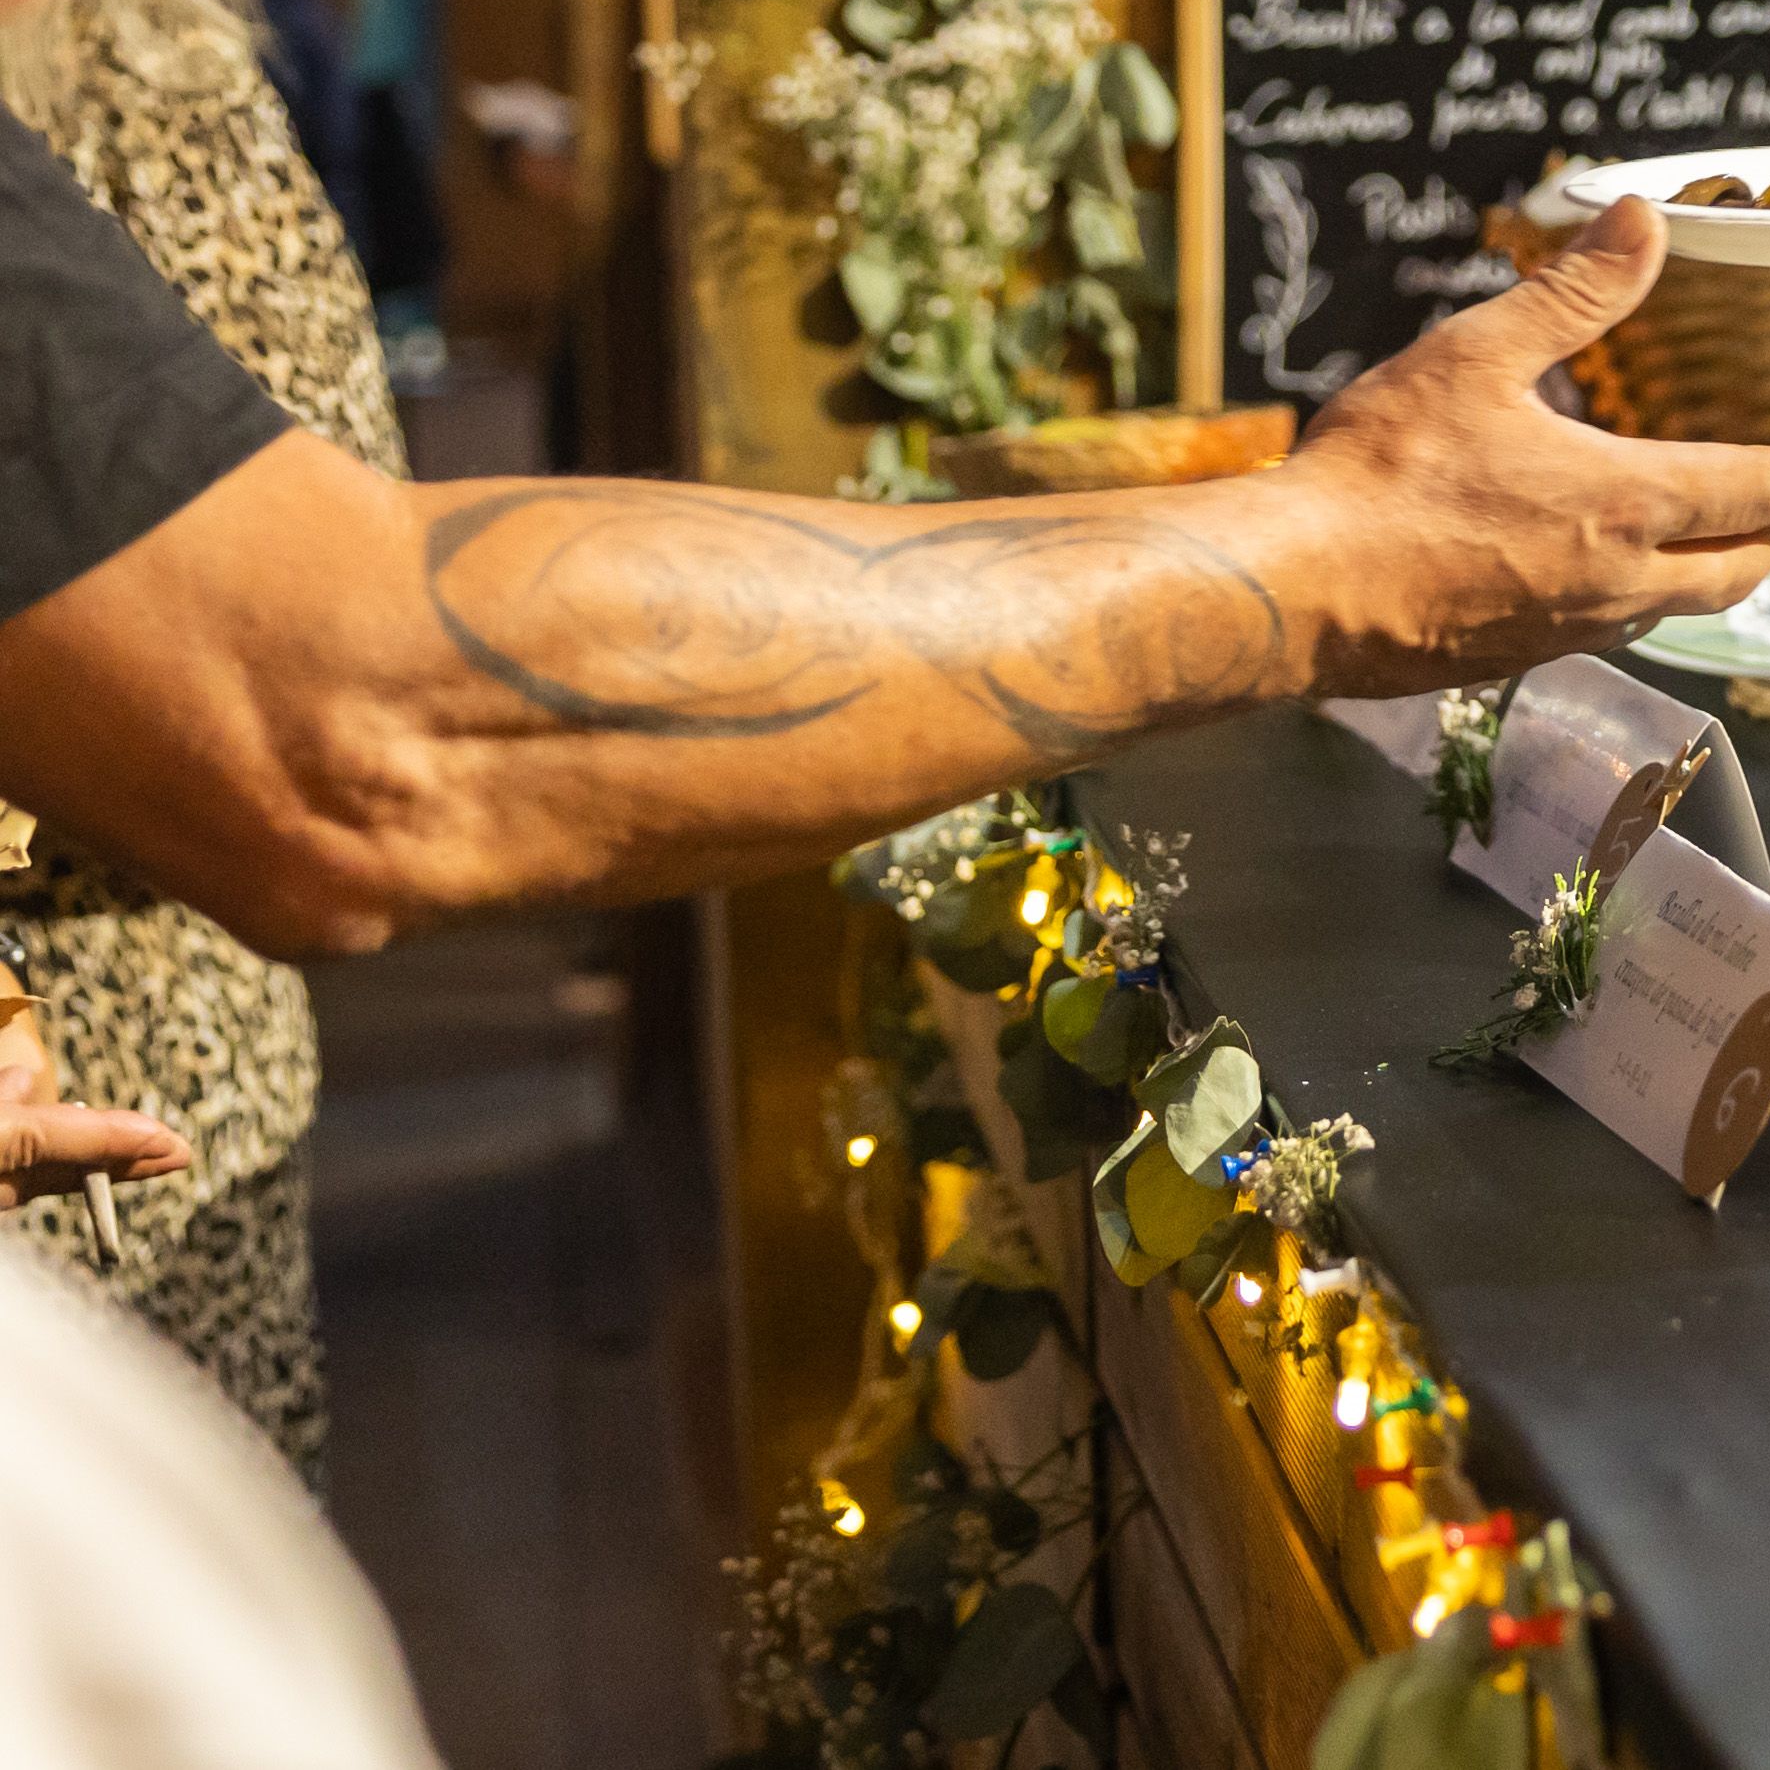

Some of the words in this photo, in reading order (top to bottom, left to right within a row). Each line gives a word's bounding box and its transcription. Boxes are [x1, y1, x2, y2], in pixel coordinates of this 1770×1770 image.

[1413, 6, 1453, 45] a
[1449, 44, 1495, 91] de
[1561, 95, 1599, 134] a
[1599, 815, 1644, 885] 5
[1713, 1065, 1761, 1132] 6
